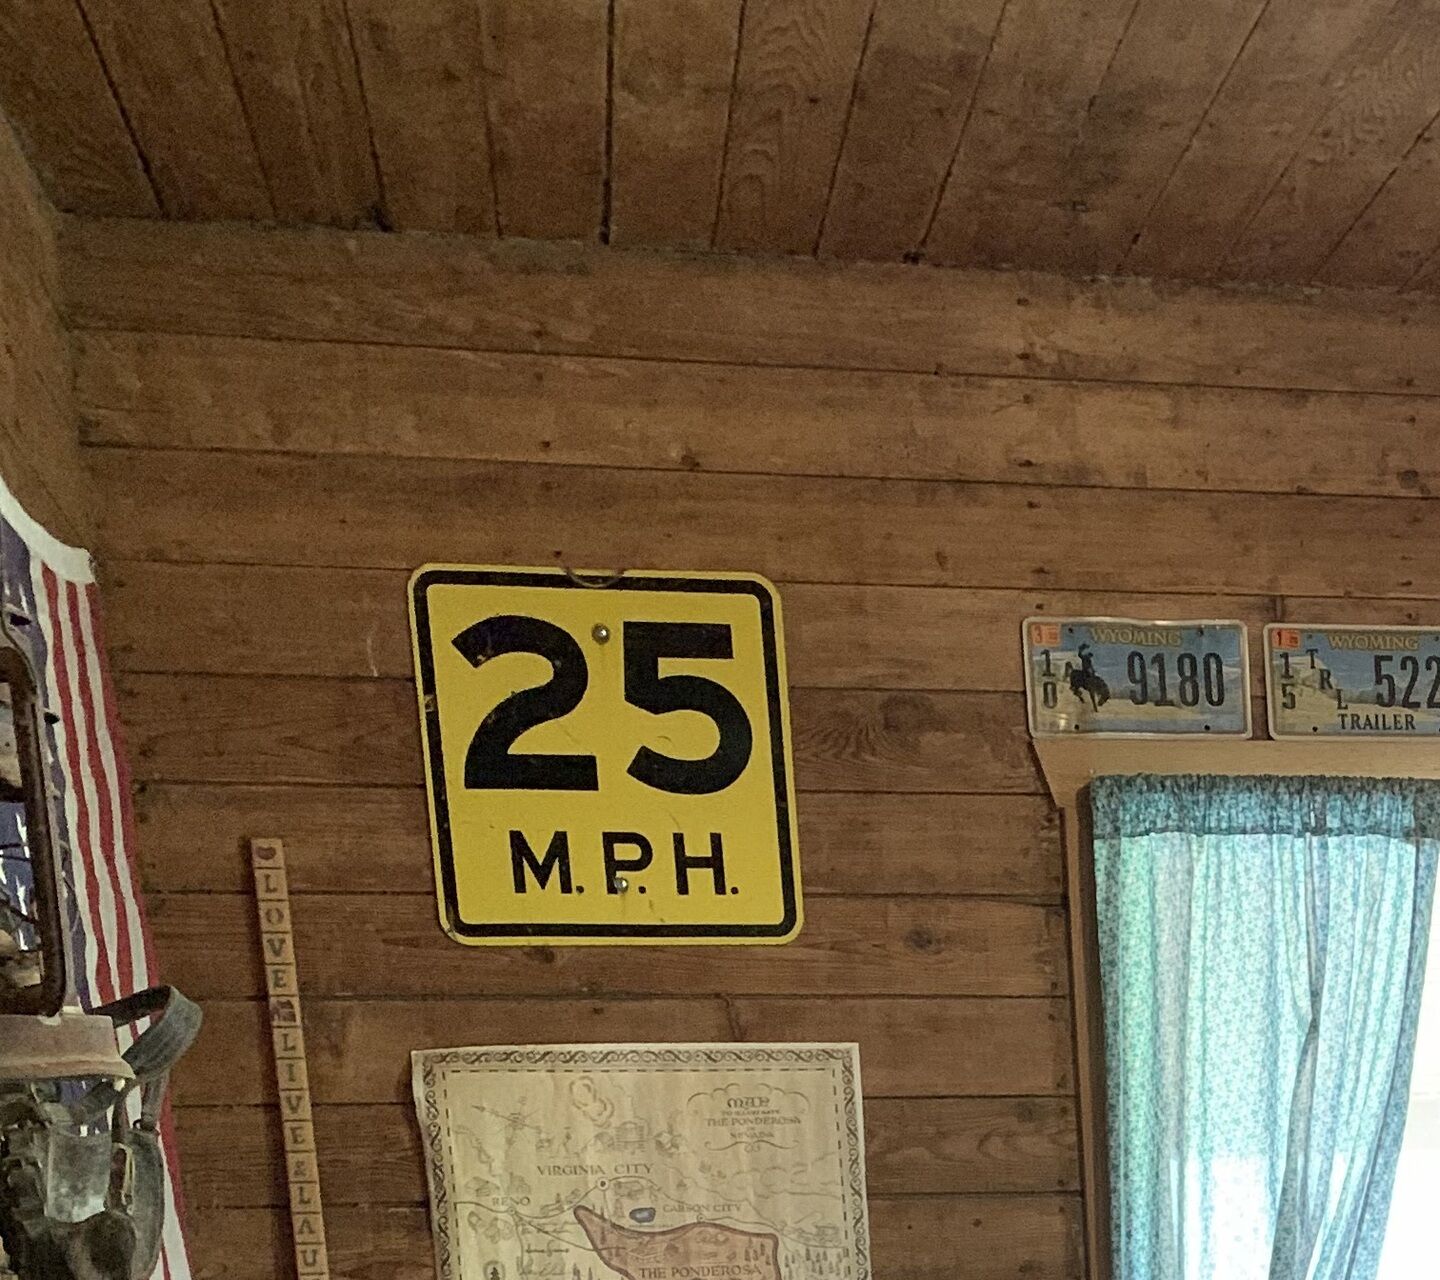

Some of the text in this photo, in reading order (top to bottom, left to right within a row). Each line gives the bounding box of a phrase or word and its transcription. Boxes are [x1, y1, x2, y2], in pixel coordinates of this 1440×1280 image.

[1089, 626, 1183, 647] WYOMING
[1328, 634, 1420, 650] WYOMING
[1127, 650, 1225, 707] 9180
[451, 615, 753, 795] 25
[1338, 714, 1416, 731] TRAILER
[537, 1163, 655, 1176] VIRGINIA CITY
[663, 1203, 742, 1213] CARSON CITY
[640, 1264, 762, 1279] THE PONDEROSA
